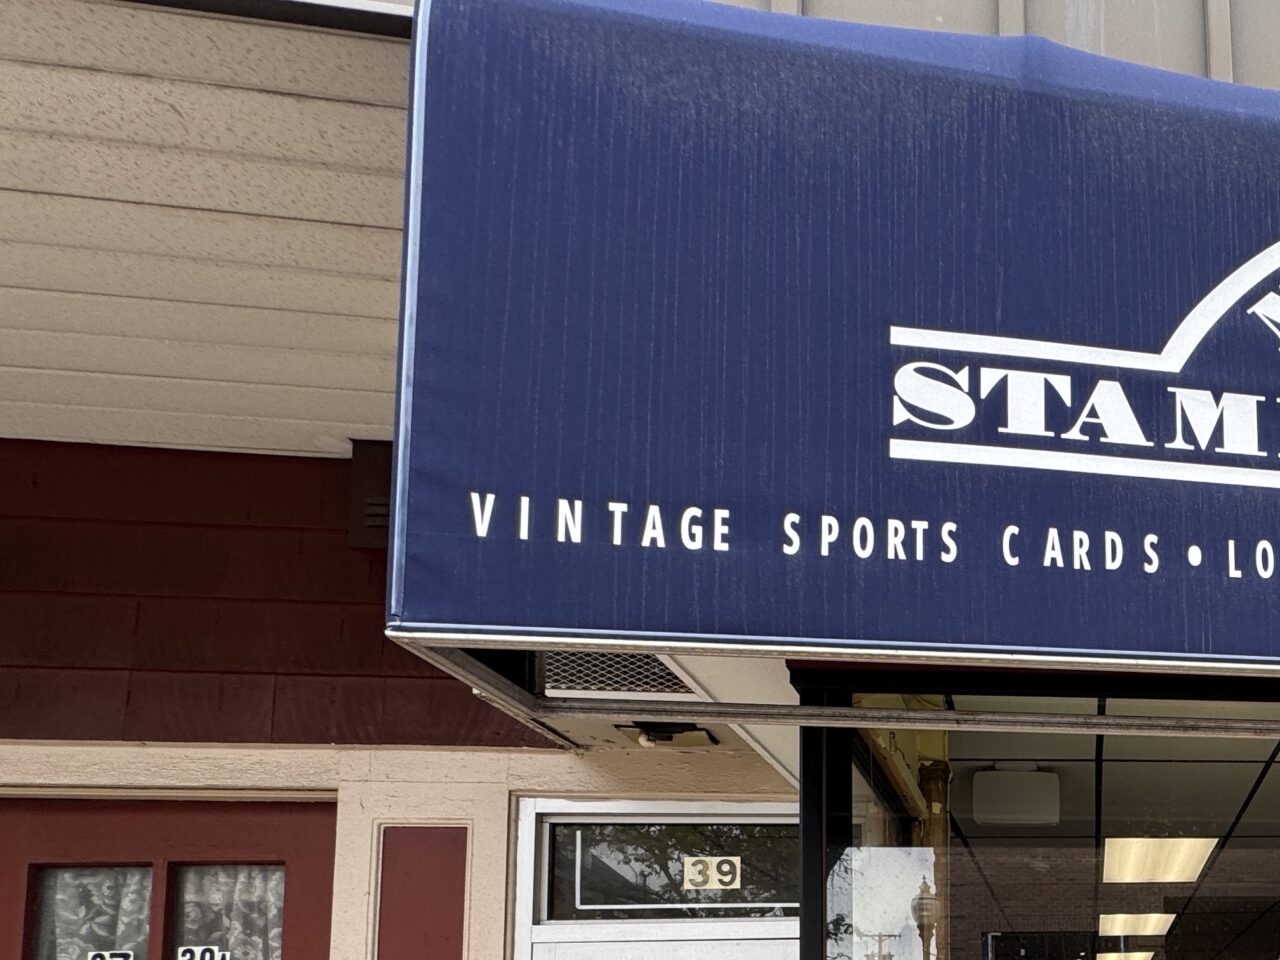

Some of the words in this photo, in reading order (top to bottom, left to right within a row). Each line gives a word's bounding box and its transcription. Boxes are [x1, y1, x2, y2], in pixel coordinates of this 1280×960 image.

[470, 492, 730, 552] VINTAGE
[782, 512, 958, 563] SPORTS
[1002, 525, 1160, 574] CARDS
[688, 858, 738, 888] 39
